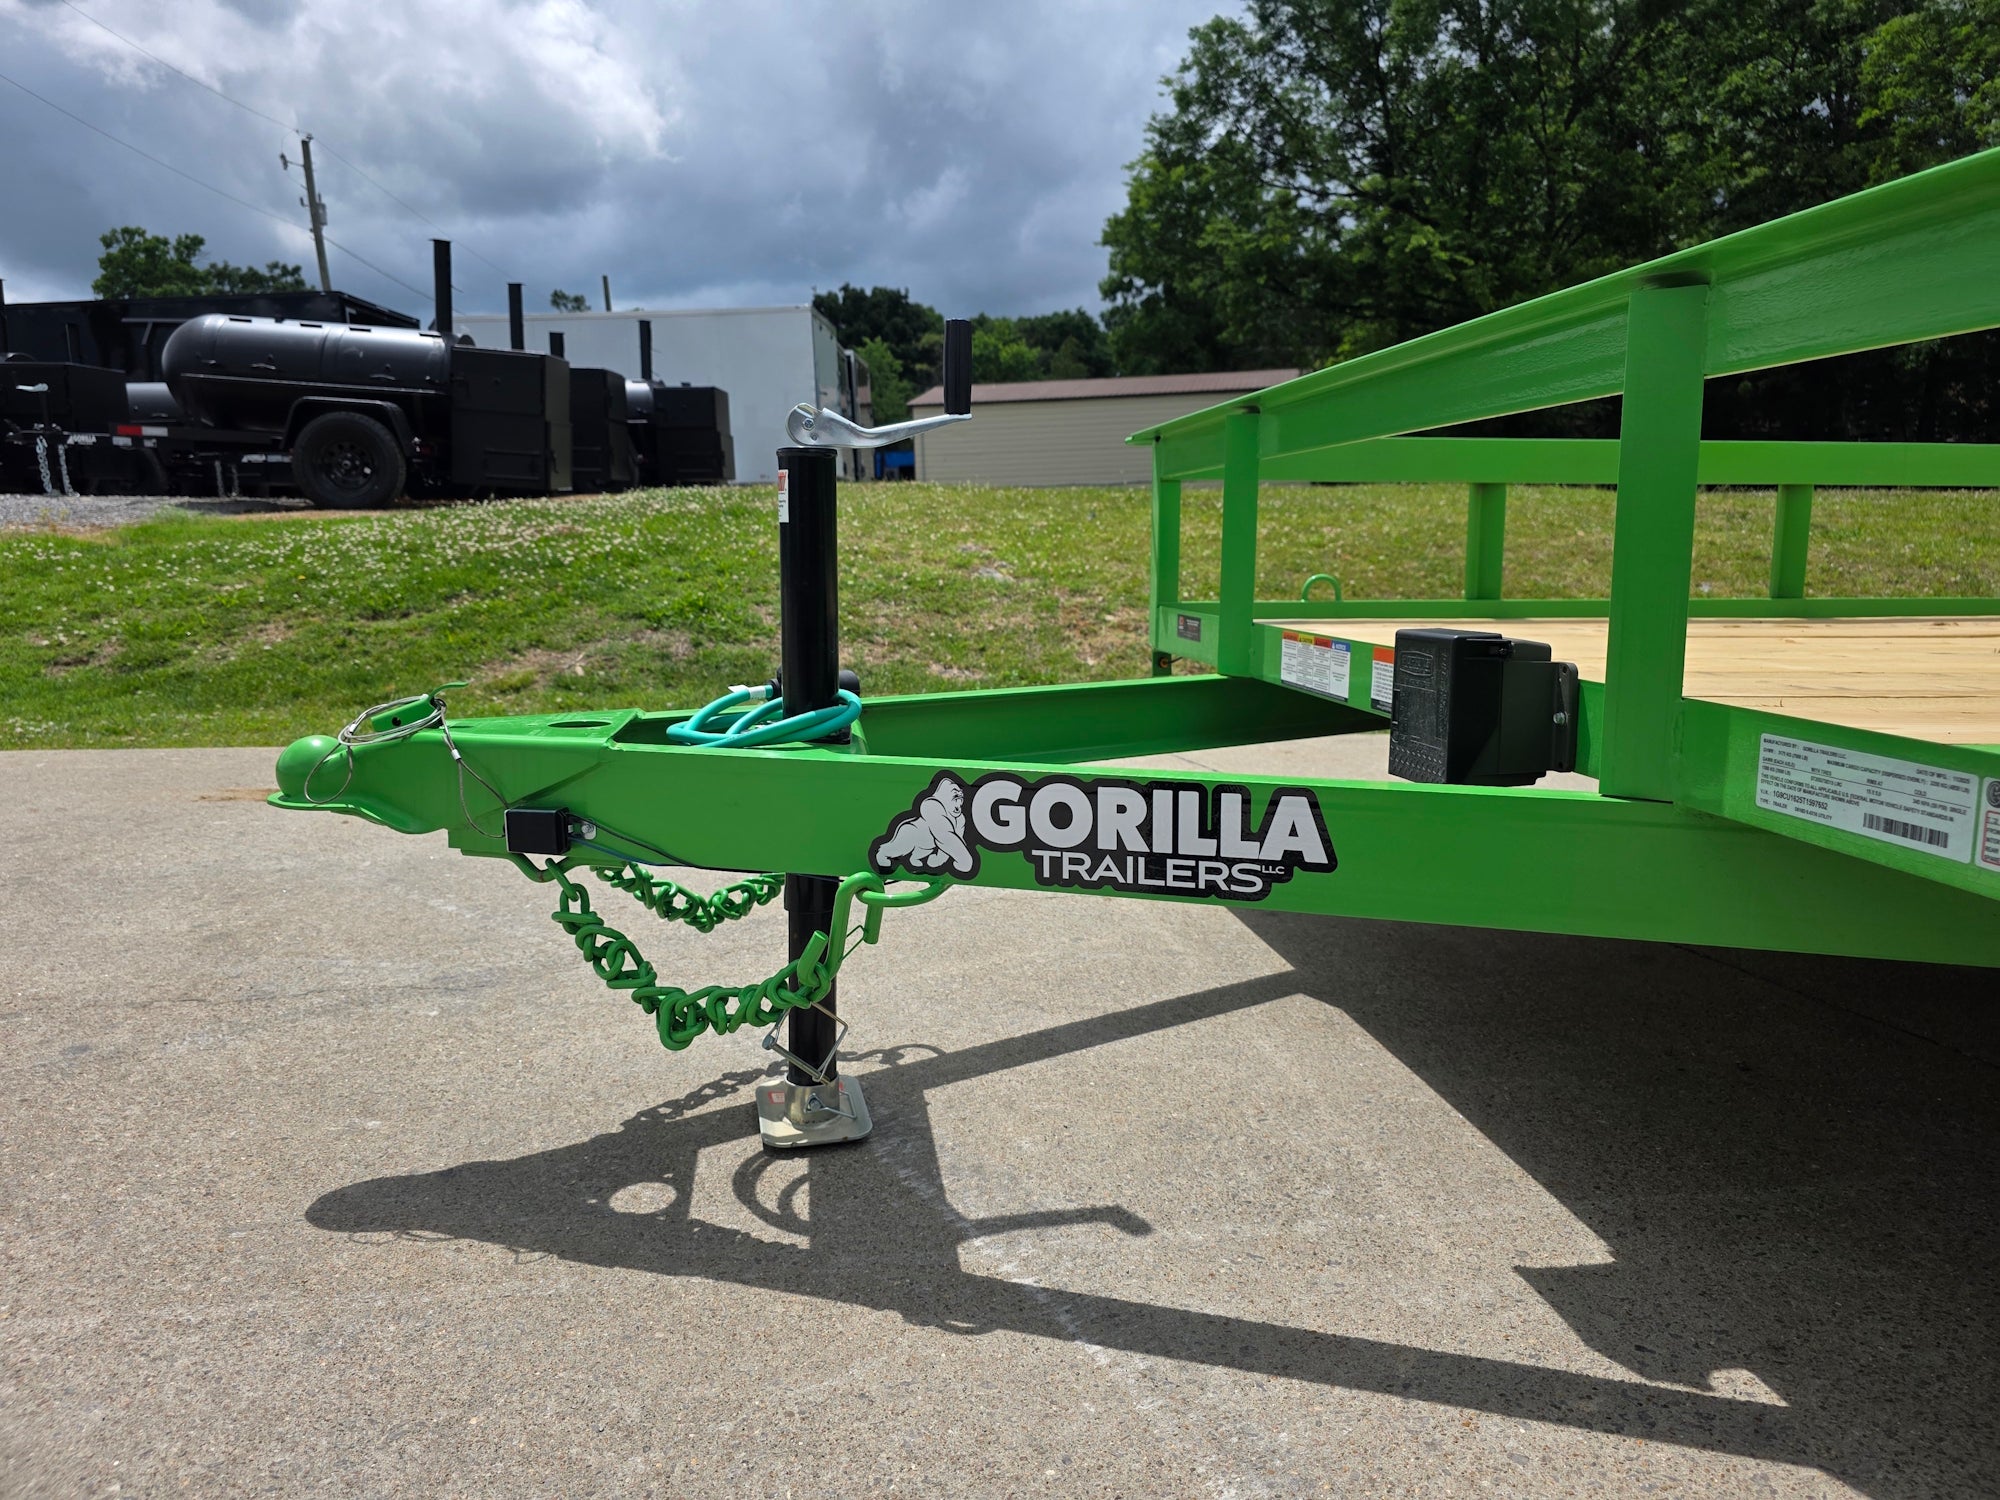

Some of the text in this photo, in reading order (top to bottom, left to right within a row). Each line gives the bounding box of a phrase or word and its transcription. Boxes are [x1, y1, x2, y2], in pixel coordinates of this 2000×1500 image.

[1802, 745, 1818, 753] GORILLA
[1818, 785, 1841, 795] APPLICABLE
[972, 780, 1328, 864] GORILLA
[1032, 850, 1285, 893] TRAILERS LLC
